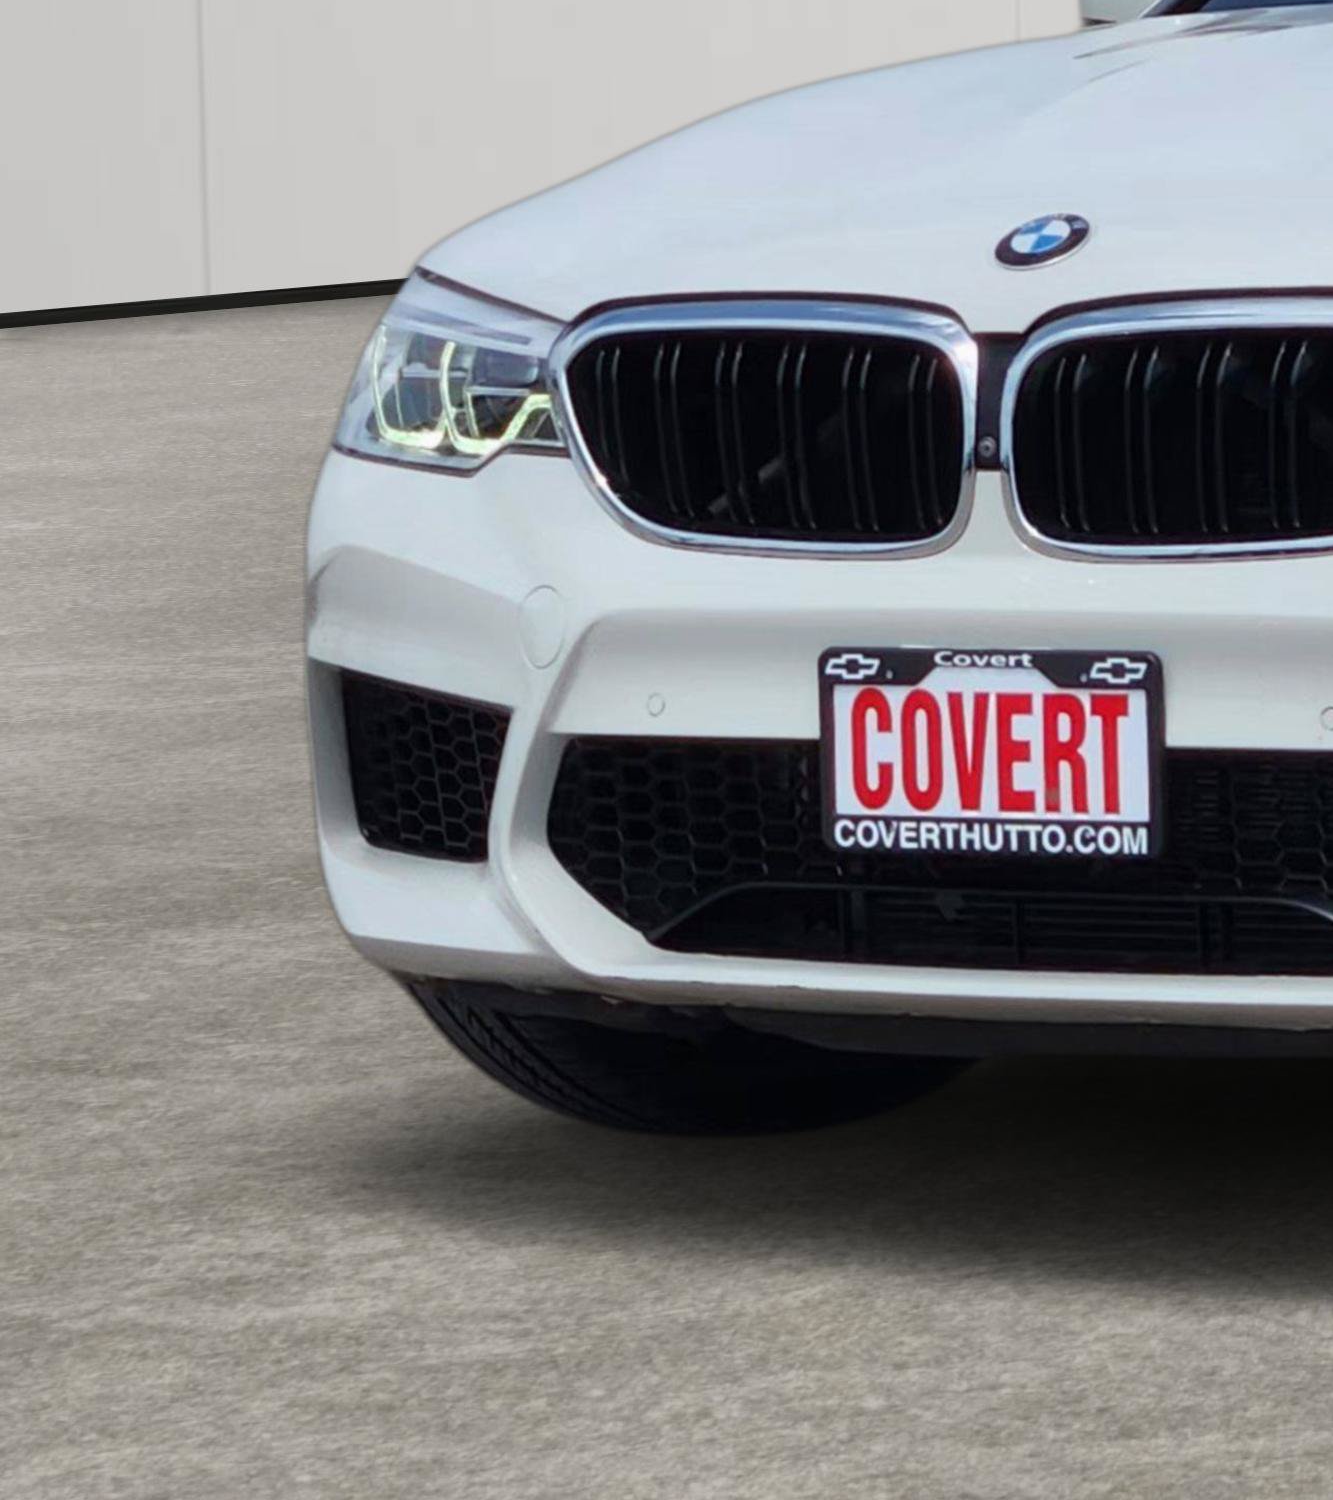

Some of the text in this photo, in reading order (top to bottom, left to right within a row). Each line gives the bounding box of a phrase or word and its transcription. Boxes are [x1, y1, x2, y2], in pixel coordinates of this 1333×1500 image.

[933, 649, 1035, 668] Covert
[851, 686, 1129, 815] COVERT
[833, 819, 1149, 855] COVERTHUTTO.COM
